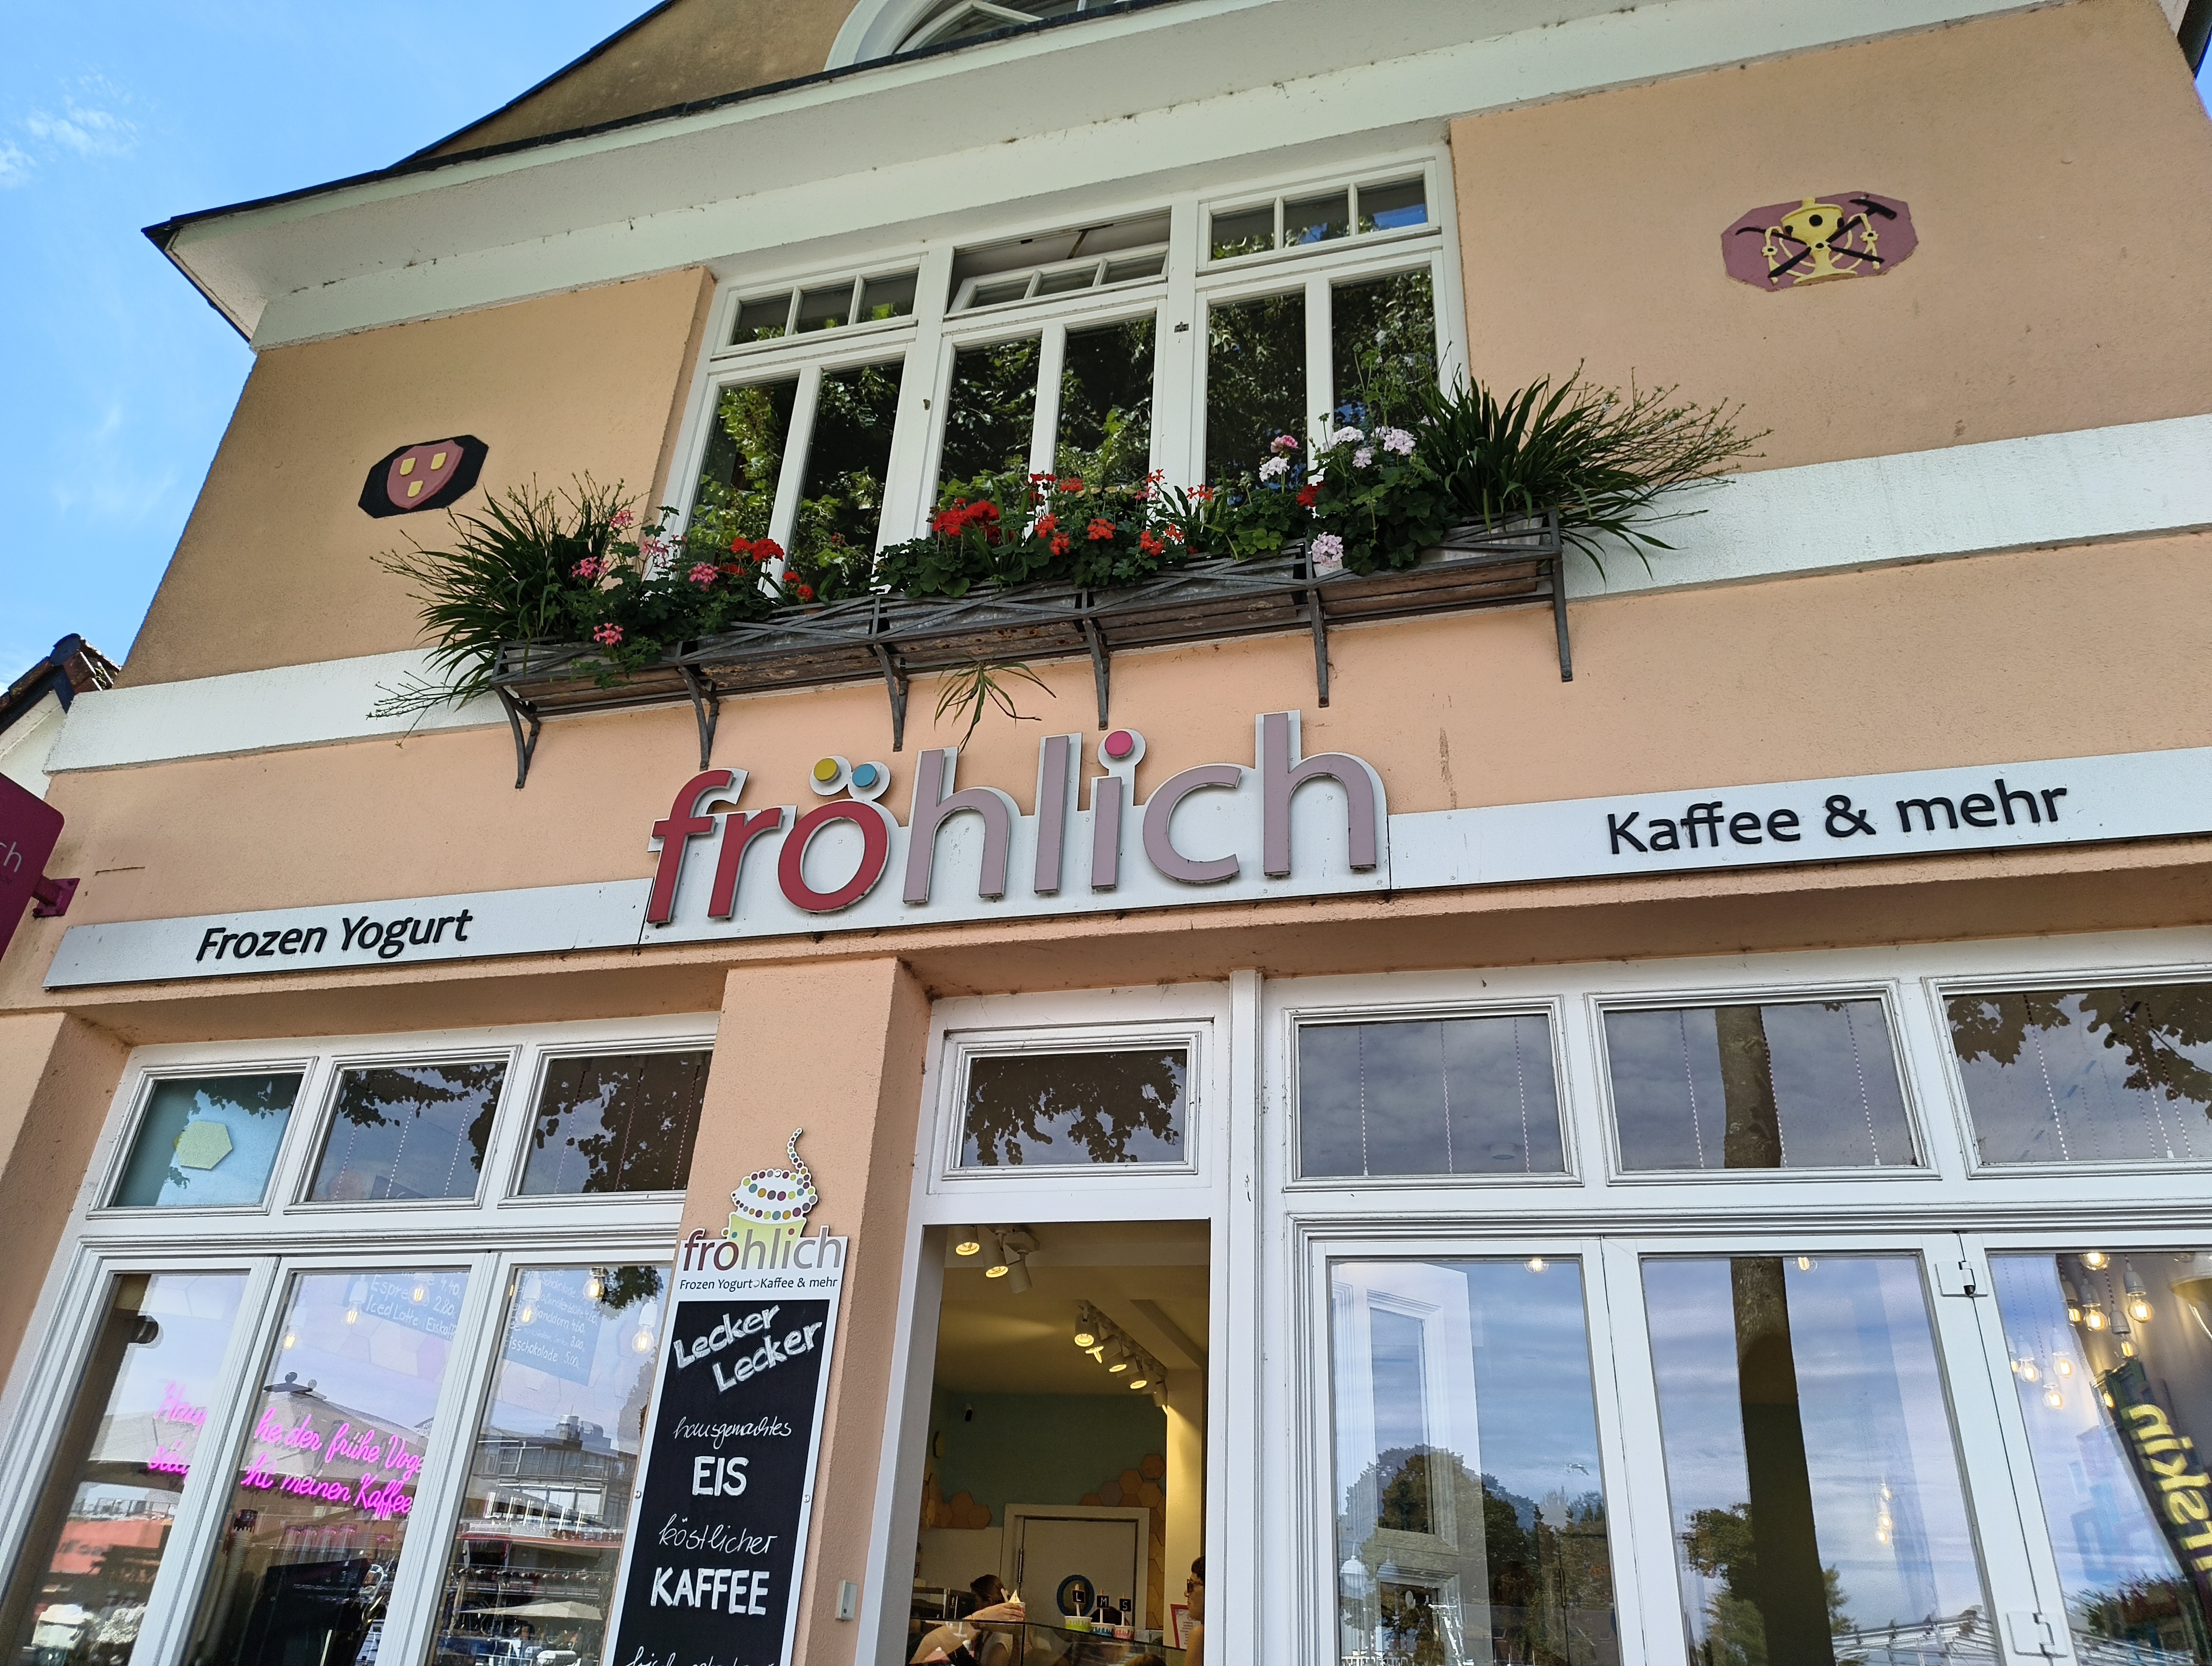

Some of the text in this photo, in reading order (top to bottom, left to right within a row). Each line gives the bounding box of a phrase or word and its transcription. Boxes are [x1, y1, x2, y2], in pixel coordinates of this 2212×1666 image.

[646, 712, 1381, 924] fröhlich
[1607, 778, 2067, 855] Kaffee & mehr
[196, 909, 473, 963] Frozen Yogurt
[683, 1227, 841, 1271] fröhlich
[679, 1276, 838, 1292] Frozen Yogurt Kaffee & mehr
[365, 1295, 394, 1318] Iced
[393, 1304, 419, 1326] Latte
[673, 1304, 781, 1369] Lecker
[712, 1322, 823, 1393] Lecker
[285, 1414, 323, 1452] der
[325, 1422, 381, 1465] frühe
[673, 1415, 792, 1450] hausgemachtes
[280, 1470, 351, 1502] meinen
[353, 1472, 413, 1520] Kaffee
[692, 1455, 749, 1497] EIS
[659, 1513, 778, 1555] köstlicher
[650, 1566, 770, 1616] KAFFEE
[1075, 1592, 1082, 1602] L
[1100, 1597, 1107, 1607] M
[1122, 1600, 1128, 1610] S
